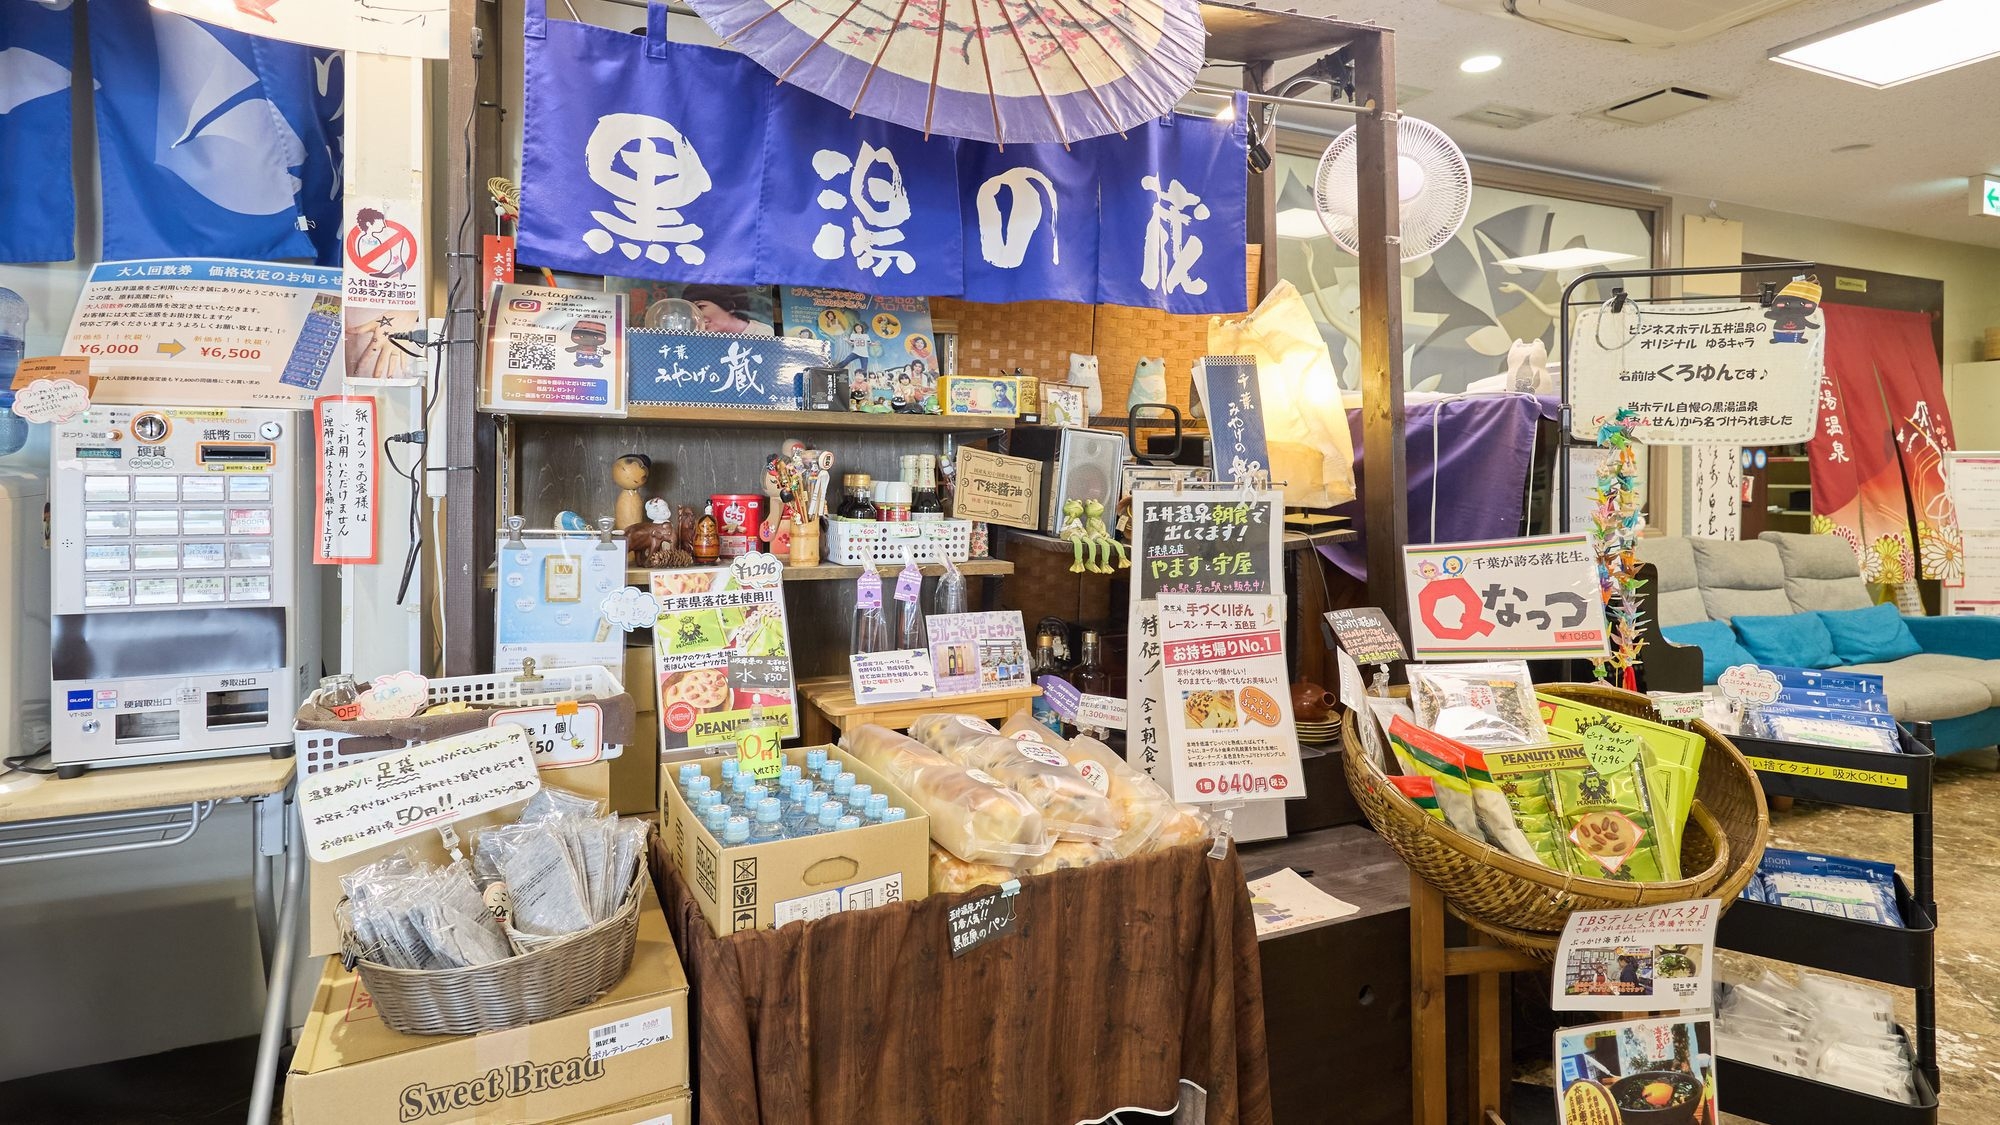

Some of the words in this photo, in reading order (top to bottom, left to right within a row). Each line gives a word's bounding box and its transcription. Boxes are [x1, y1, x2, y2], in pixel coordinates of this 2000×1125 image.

[582, 113, 1210, 294] 黒湯の蔵
[116, 265, 193, 277] 大人回数券
[209, 265, 342, 286] 価格改定のお知らせ
[348, 278, 416, 290] 入れ墨・タトゥー
[348, 287, 416, 298] のある方お断り!
[522, 289, 597, 301] Instagram
[1629, 322, 1766, 336] ビジネスホテル五井温泉の
[79, 343, 139, 355] ¥6,000
[1641, 337, 1697, 349] オリジナル
[1705, 337, 1755, 349] ゆるキャラ
[200, 347, 261, 360] ¥6,500
[658, 345, 689, 360] 千葉
[655, 341, 765, 397] みやげの蔵
[1238, 373, 1255, 410] 千葉
[1628, 401, 1758, 413] 当ホテル自慢の黒湯温泉
[203, 429, 231, 441] 紙幣
[137, 446, 167, 457] 硬貨
[355, 409, 369, 522] 紙オムツのお客様は
[338, 424, 350, 537] ご利用いただけません
[725, 511, 743, 521] ビスコ
[1145, 503, 1268, 525] 五井温泉朝食で
[1165, 524, 1249, 542] 出してます!
[1148, 544, 1184, 556] 千葉県名店
[1473, 551, 1590, 570] 千葉が誇る落花生。
[663, 592, 774, 610] 千葉県落花生使用!!
[1187, 603, 1254, 617] 手づくりぱん
[1418, 577, 1588, 641] Qなっつ
[1168, 620, 1257, 630] レーズン・チーズ・五色豆
[1560, 631, 1595, 641] ¥1080
[663, 650, 739, 662] サクサクのクッキー生地に
[1173, 637, 1272, 661] お持ち帰りNo.1
[736, 668, 756, 682] 水
[1177, 668, 1247, 676] 素朴な味わいが懐かしい!
[221, 678, 256, 687] 券取出口
[1859, 680, 1867, 693] 1
[124, 699, 171, 708] 硬貨取出口
[1245, 688, 1272, 709] しっとり
[1864, 699, 1873, 711] 1
[1241, 699, 1276, 723] ふわふわ!
[543, 726, 547, 734] 1
[555, 722, 567, 734] 個
[1870, 717, 1878, 726] 1
[1501, 749, 1556, 764] PEANUTS
[1832, 768, 1883, 783] 吸水OK!
[1218, 773, 1267, 794] 640円
[1271, 777, 1286, 787] 税込
[1866, 869, 1874, 878] 1
[948, 896, 996, 921] 五井温泉スタッフ
[1578, 904, 1710, 927] TBSテレビ『Nスタ』
[1570, 935, 1637, 946] ぶっかけ海苔めし
[402, 1073, 501, 1120] Sweet
[508, 1058, 604, 1097] Bread
